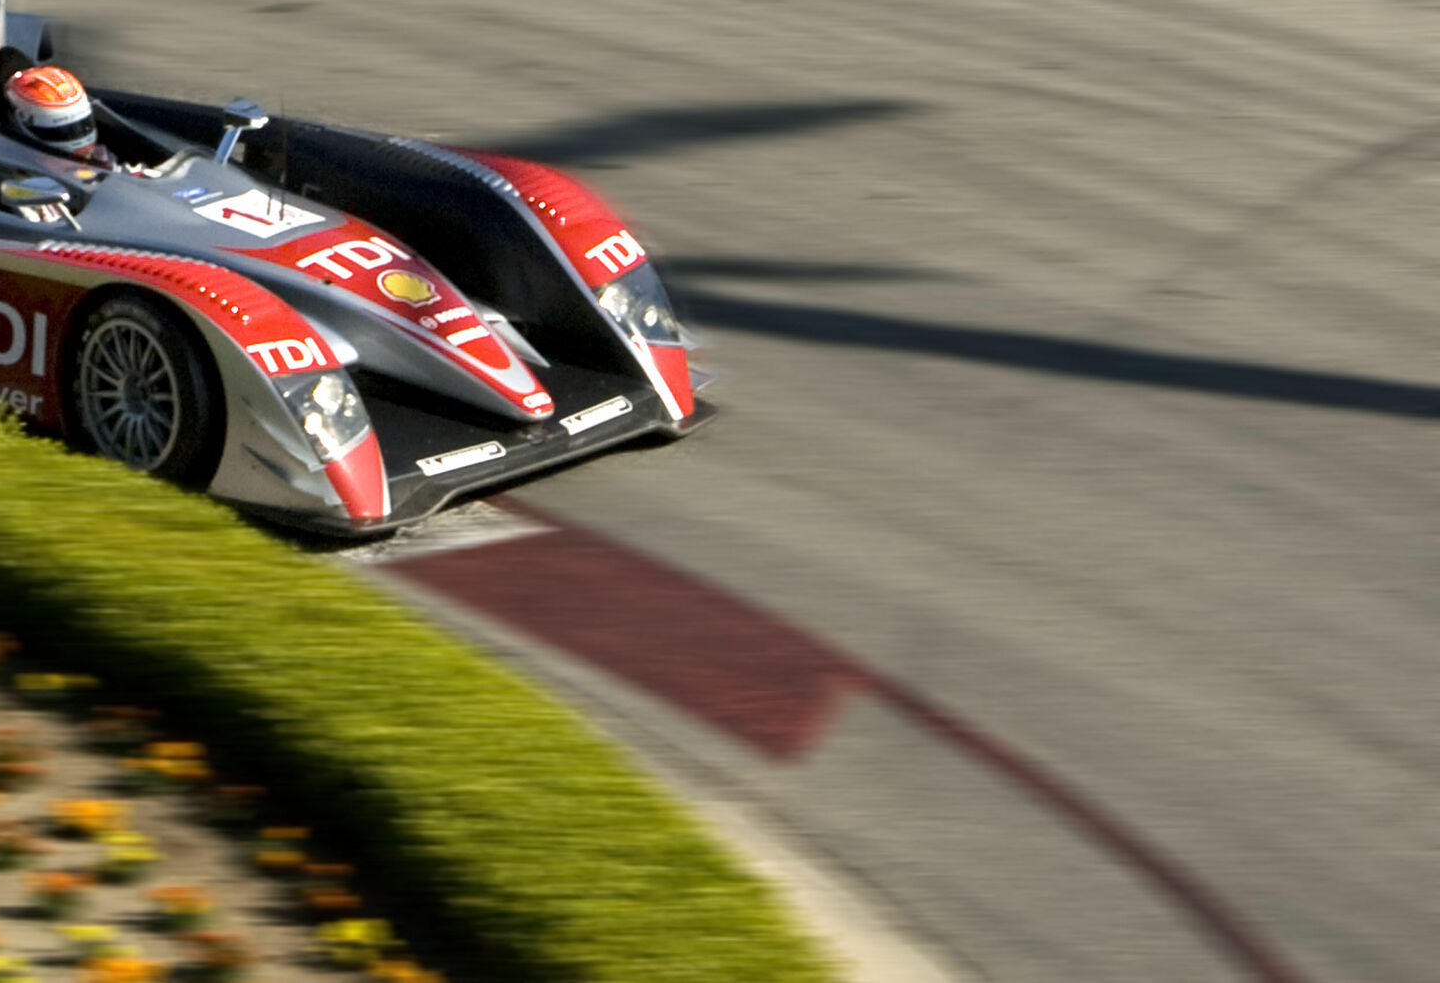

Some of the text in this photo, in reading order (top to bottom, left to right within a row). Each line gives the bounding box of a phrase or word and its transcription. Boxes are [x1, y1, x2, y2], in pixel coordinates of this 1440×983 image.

[296, 236, 411, 280] TDI
[584, 229, 646, 274] TDI
[246, 337, 327, 373] TDI
